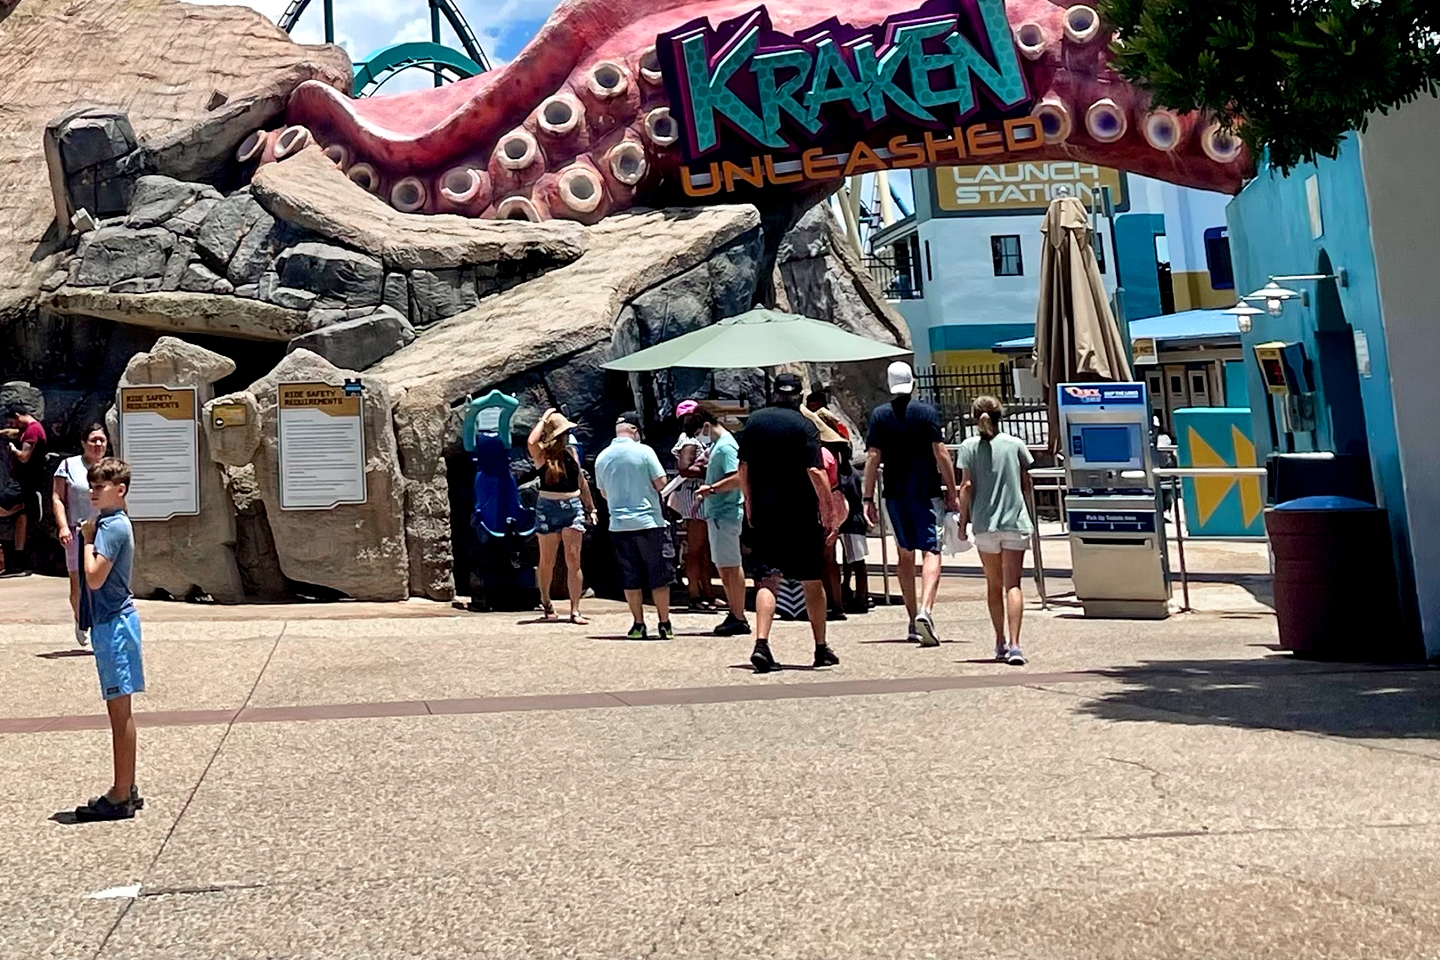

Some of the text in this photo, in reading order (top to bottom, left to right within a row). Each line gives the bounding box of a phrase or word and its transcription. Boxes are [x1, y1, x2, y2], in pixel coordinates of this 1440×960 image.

[678, 114, 1045, 198] UNLEASHED
[952, 161, 1100, 184] LAUNCH
[956, 181, 1100, 205] STATION
[126, 401, 180, 410] REQUIREMENTS
[284, 397, 343, 406] REQUIREMENTS
